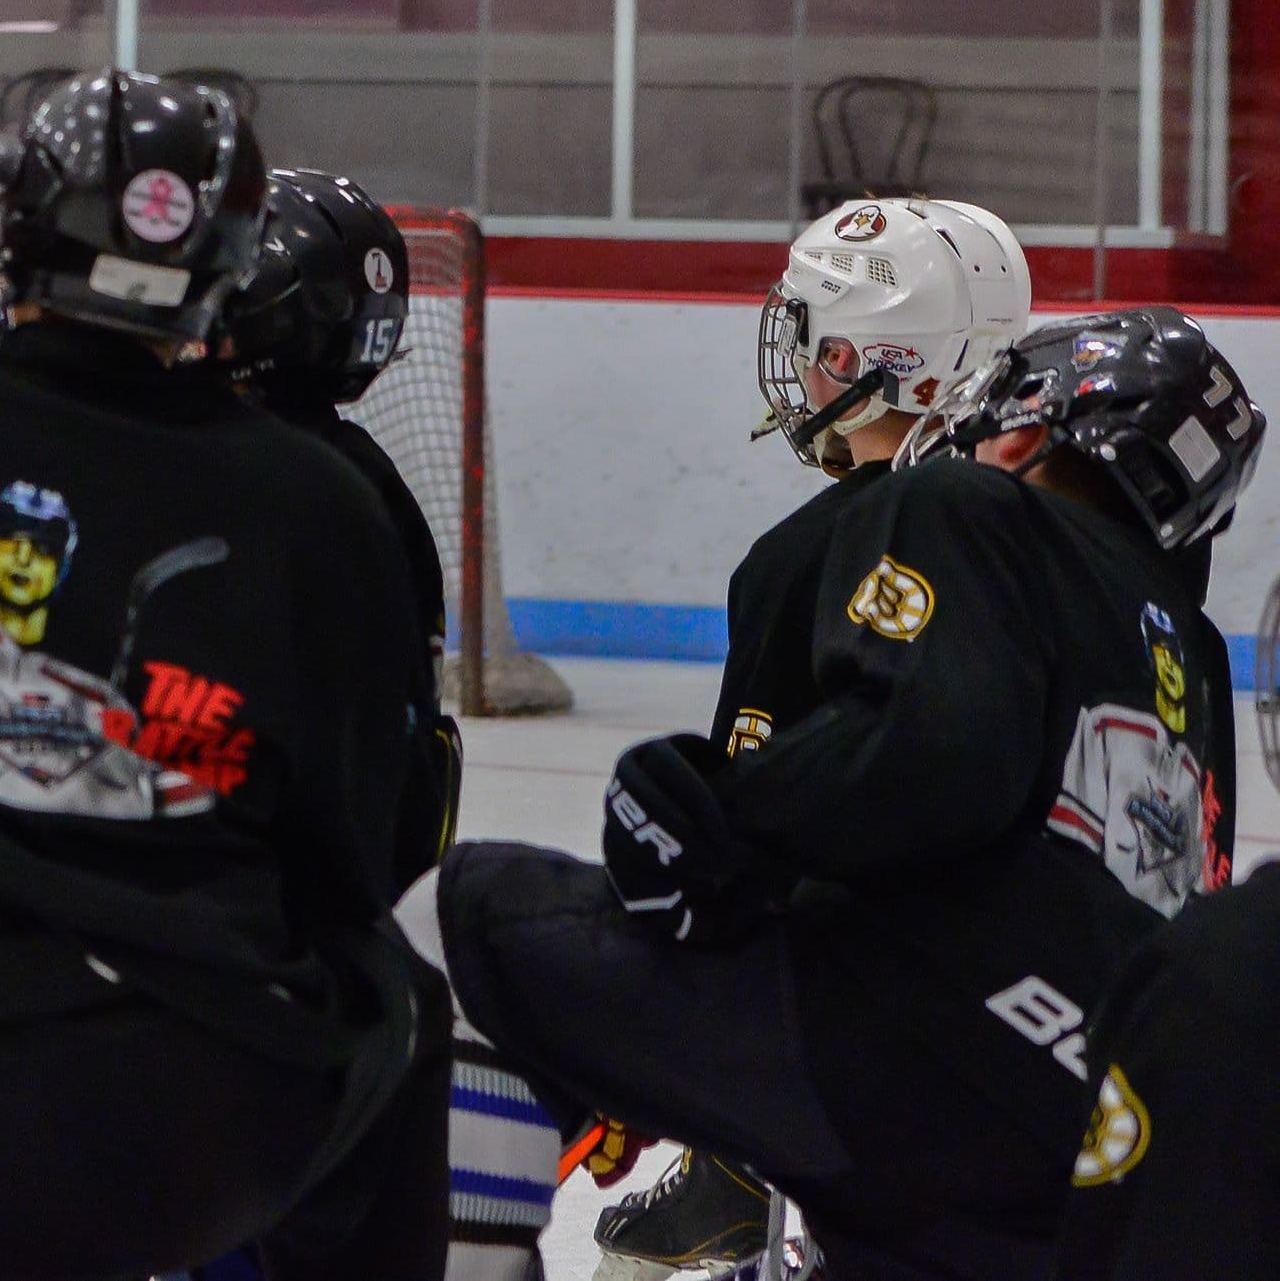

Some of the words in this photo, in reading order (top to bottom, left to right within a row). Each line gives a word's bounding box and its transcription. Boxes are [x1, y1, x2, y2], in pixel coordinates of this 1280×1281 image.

[360, 319, 393, 363] 15
[880, 348, 903, 361] USA
[867, 357, 916, 374] HOCKEY
[912, 376, 941, 407] 4
[143, 660, 245, 731] THE
